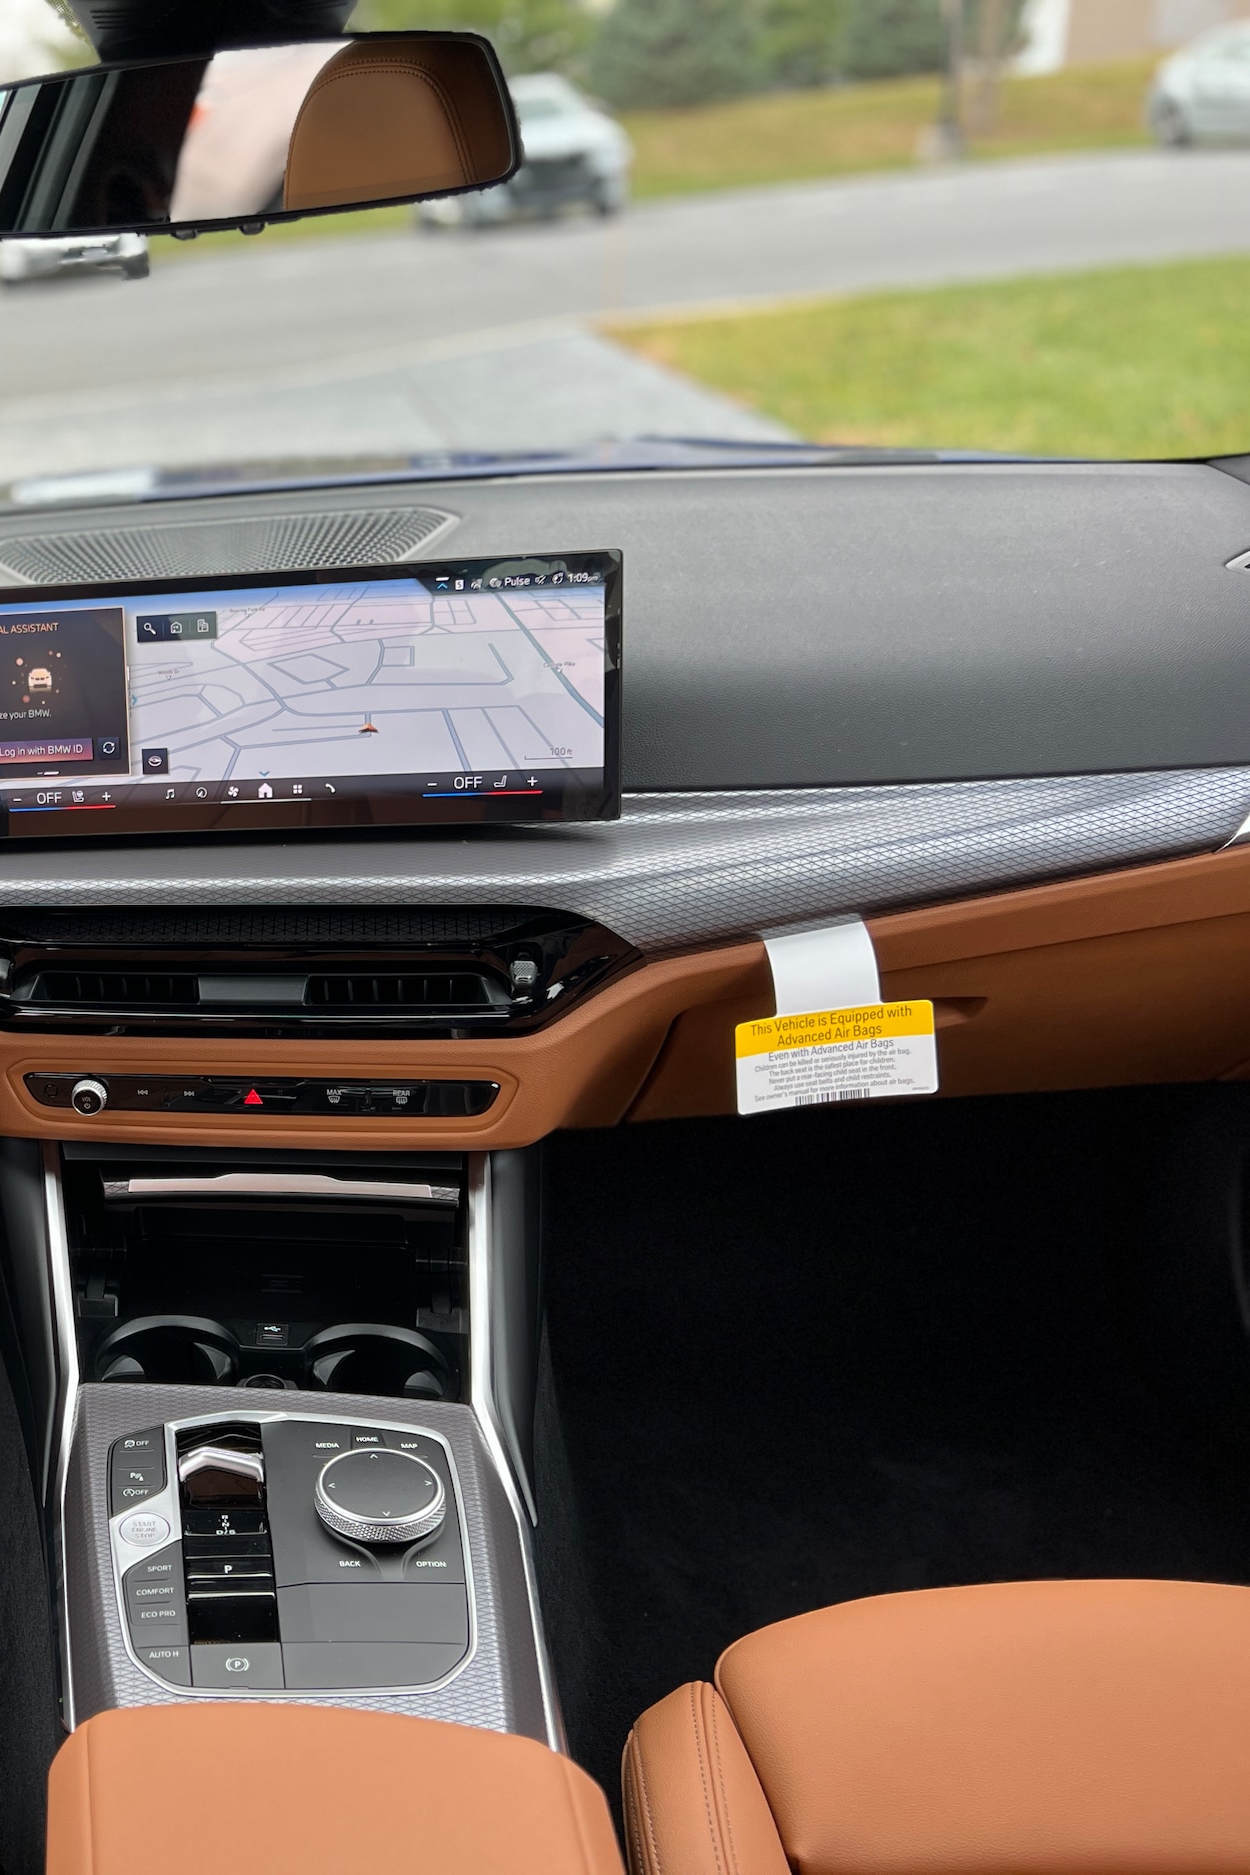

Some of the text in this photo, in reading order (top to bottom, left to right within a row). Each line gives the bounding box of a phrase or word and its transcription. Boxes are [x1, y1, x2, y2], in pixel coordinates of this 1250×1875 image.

[504, 576, 530, 586] Pulse
[10, 622, 59, 634] ASSISTANT
[8, 711, 27, 721] your
[28, 709, 52, 718] BMW.
[0, 744, 83, 758] Log in with BMW ID
[550, 747, 566, 756] 100
[453, 776, 482, 789] OFF
[36, 792, 62, 804] OFF
[751, 1005, 912, 1036] This Vehicle is Equipped with
[777, 1025, 882, 1046] Advanced Air Bags
[768, 1039, 894, 1062] Even with Advanced Air Bags
[754, 1063, 777, 1073] Children
[797, 1057, 813, 1066] killed
[821, 1053, 846, 1063] seriously
[847, 1051, 868, 1060] injured
[869, 1050, 876, 1058] by
[824, 1062, 842, 1070] safest
[843, 1060, 859, 1068] place
[769, 1077, 785, 1085] Never
[773, 1083, 793, 1091] Always
[788, 1088, 809, 1096] manual
[835, 1081, 869, 1090] information
[147, 1564, 172, 1573] SPORT
[224, 1565, 233, 1574] P
[136, 1587, 174, 1596] COMFORT
[141, 1610, 176, 1619] ECO PRO
[149, 1651, 171, 1659] AUTO
